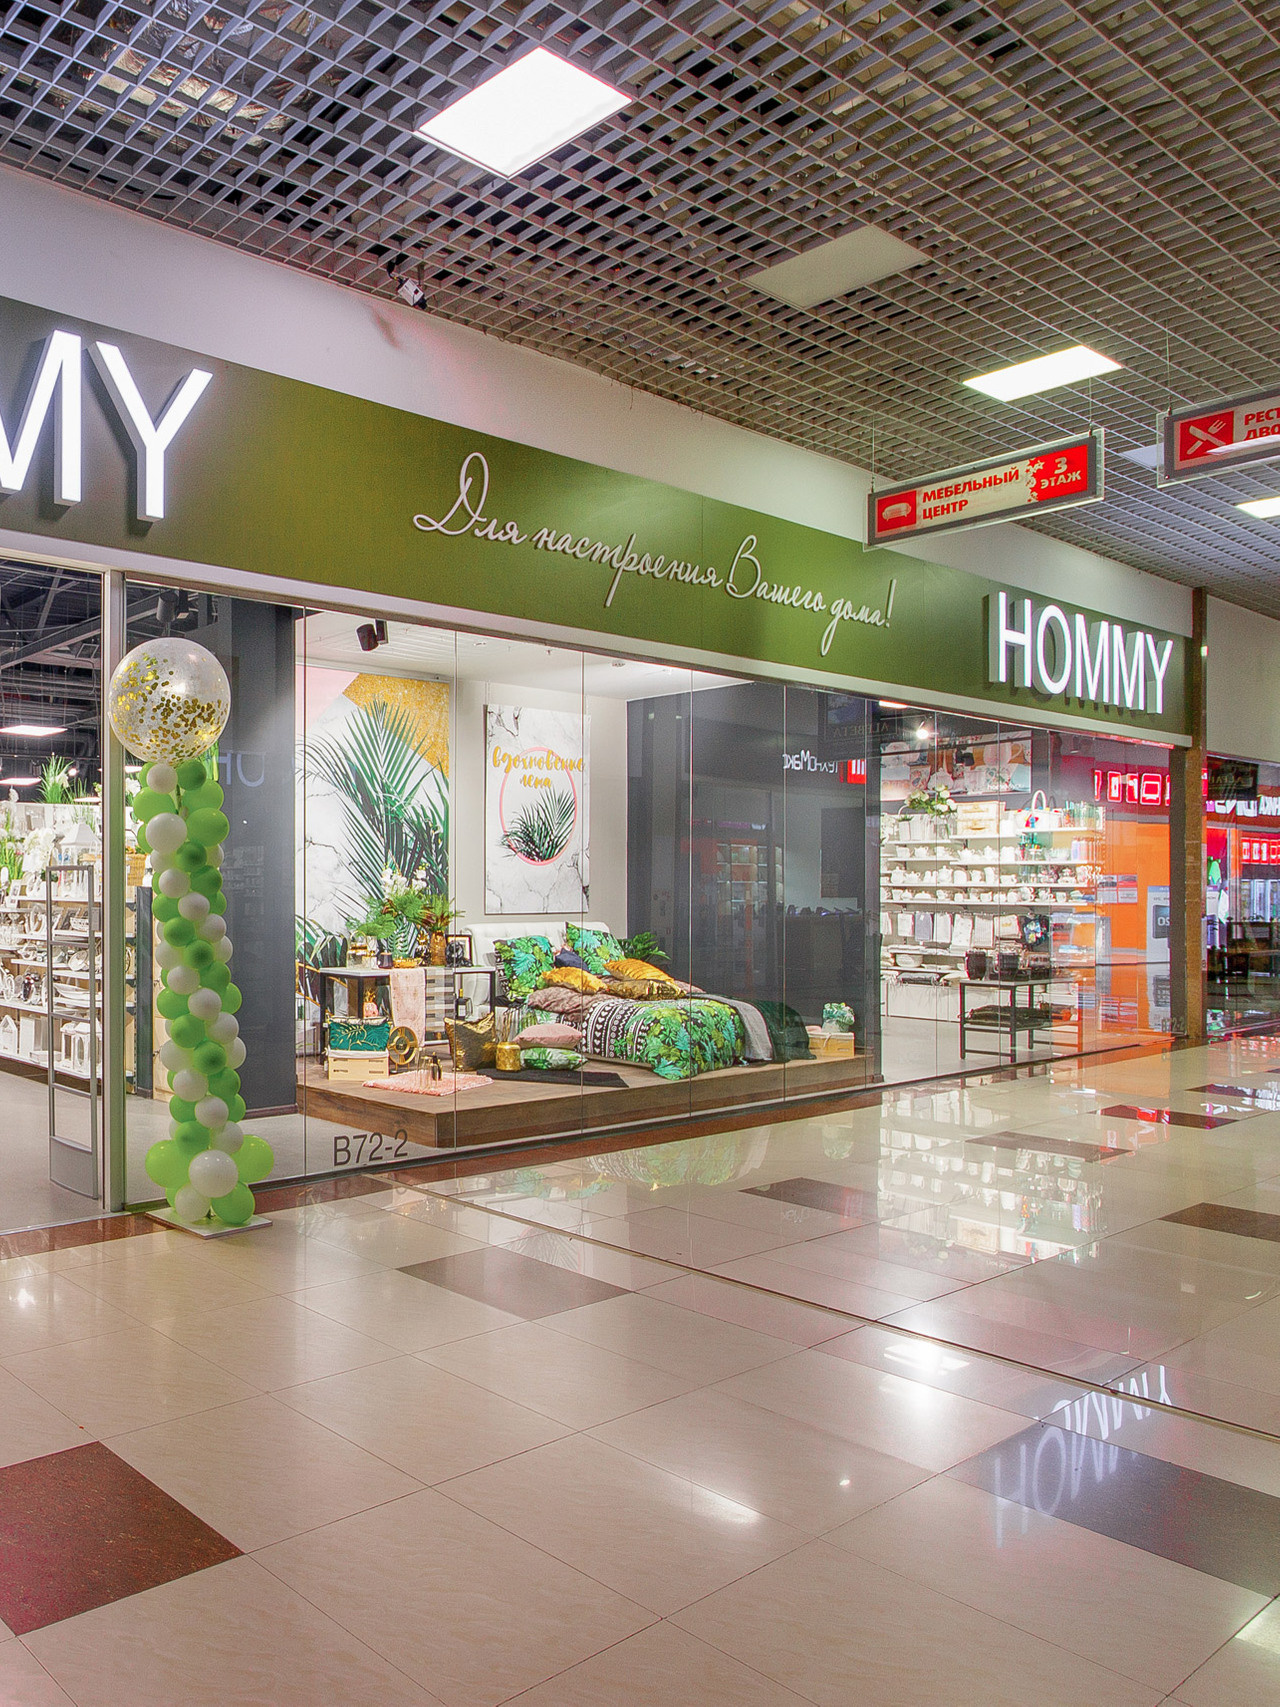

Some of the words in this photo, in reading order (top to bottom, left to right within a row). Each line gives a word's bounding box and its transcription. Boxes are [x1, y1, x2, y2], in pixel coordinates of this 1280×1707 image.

[1039, 469, 1082, 490] ЭТАЖ
[1053, 456, 1068, 475] 3
[922, 466, 1020, 504] МЕБЕЛЬНЫЙ
[922, 498, 969, 521] ЦЕНТР
[413, 451, 528, 545] Для
[531, 527, 724, 608] настроения
[724, 534, 827, 612] Вашего
[820, 578, 897, 657] дома!
[990, 591, 1174, 714] HOMMY
[333, 1128, 409, 1167] B72-2
